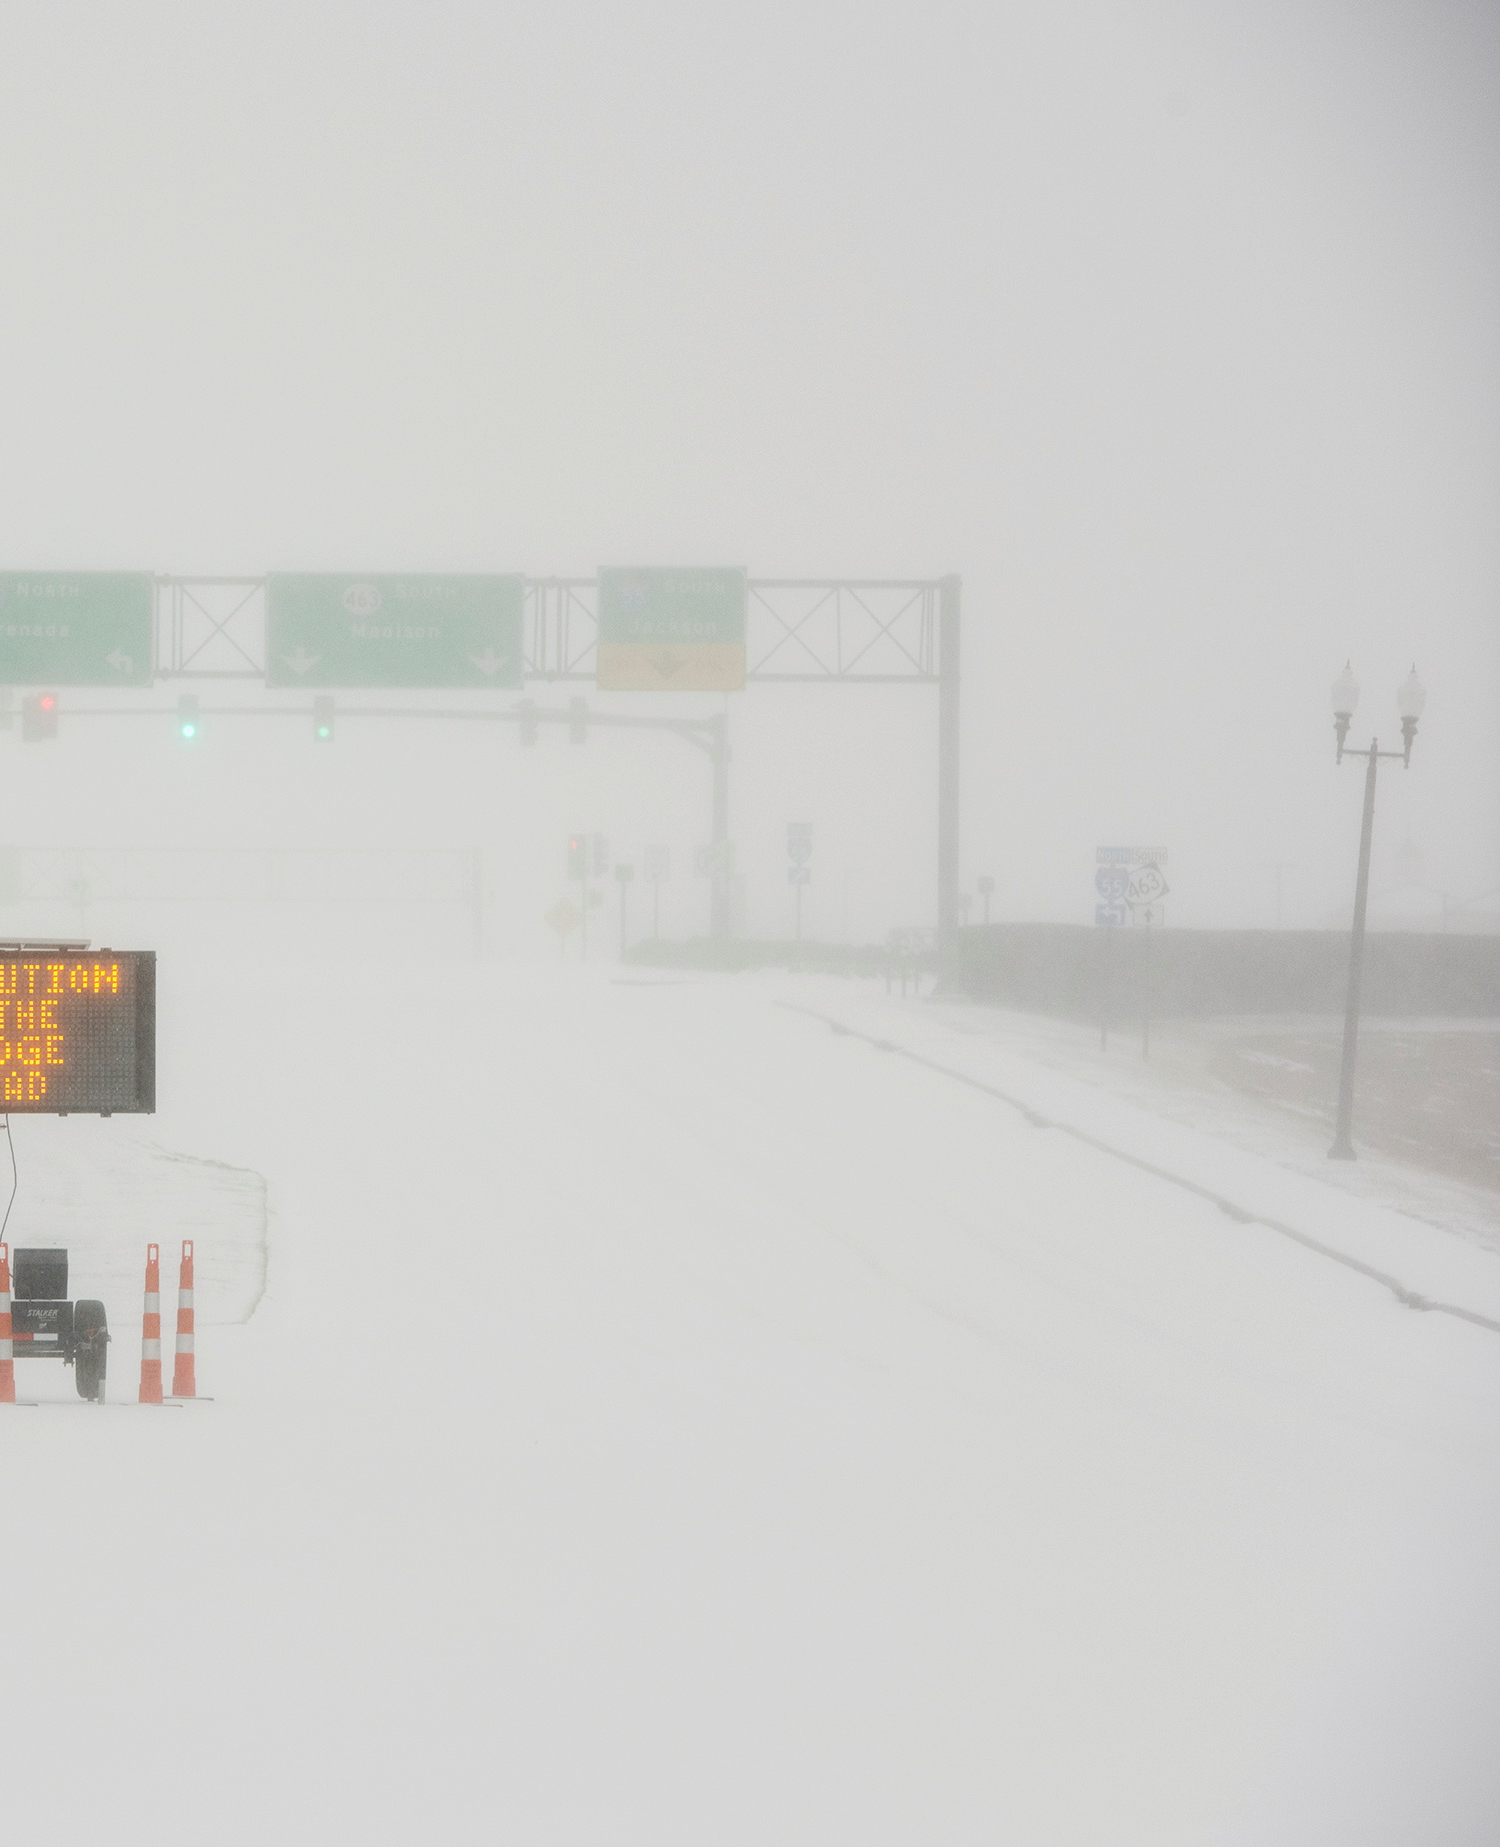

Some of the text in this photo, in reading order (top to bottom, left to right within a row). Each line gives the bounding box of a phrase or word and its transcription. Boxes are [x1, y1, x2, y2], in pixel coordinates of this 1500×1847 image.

[345, 590, 379, 608] 463
[351, 622, 440, 639] Madison
[627, 617, 718, 635] Jackson
[1098, 848, 1131, 863] NORTH
[1134, 849, 1166, 862] SOUTH
[1101, 878, 1123, 896] 55
[1128, 872, 1160, 898] 463
[27, 1309, 60, 1317] STALKER
